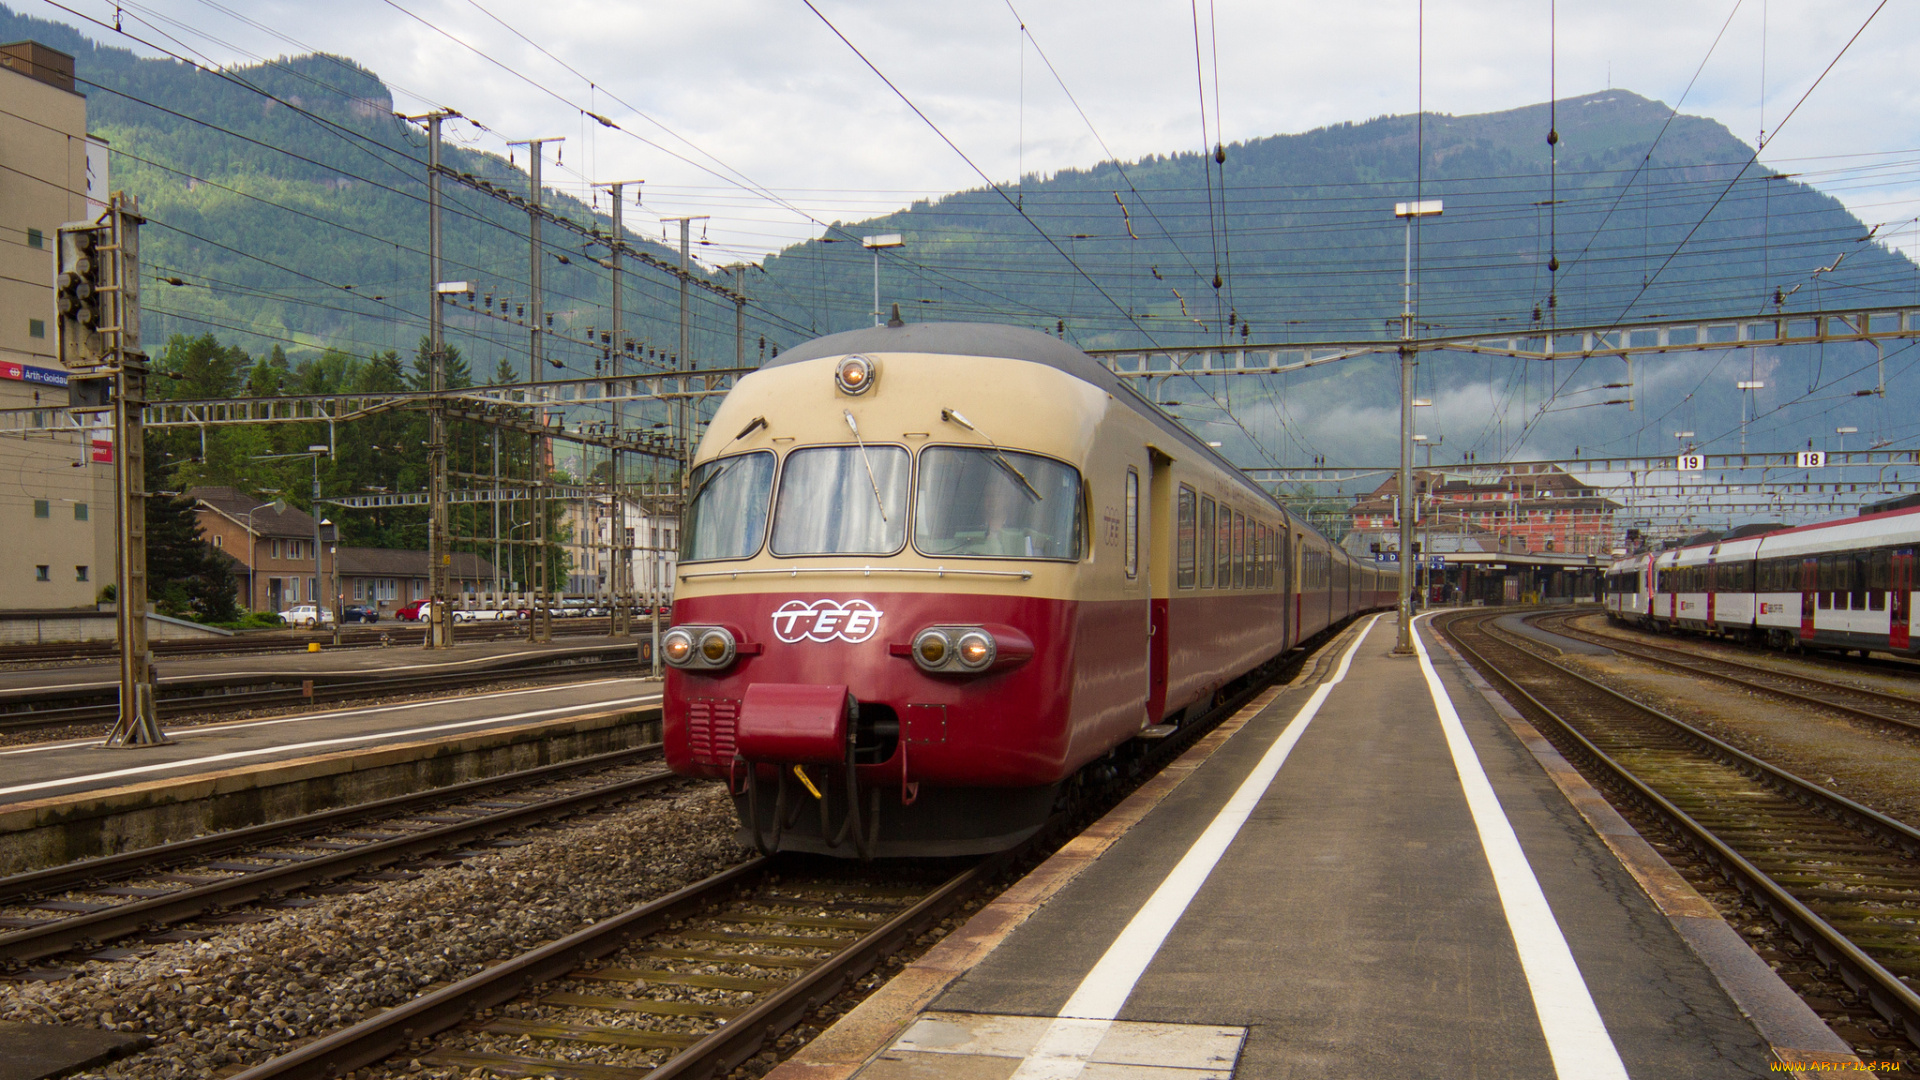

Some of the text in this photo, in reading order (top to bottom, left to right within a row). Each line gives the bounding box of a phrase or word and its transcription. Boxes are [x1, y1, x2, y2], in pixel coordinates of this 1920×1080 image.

[25, 370, 68, 385] Arth-Goldau
[1684, 456, 1699, 469] 19
[1804, 453, 1819, 466] 18
[1378, 553, 1384, 561] 3
[771, 609, 884, 634] TEE
